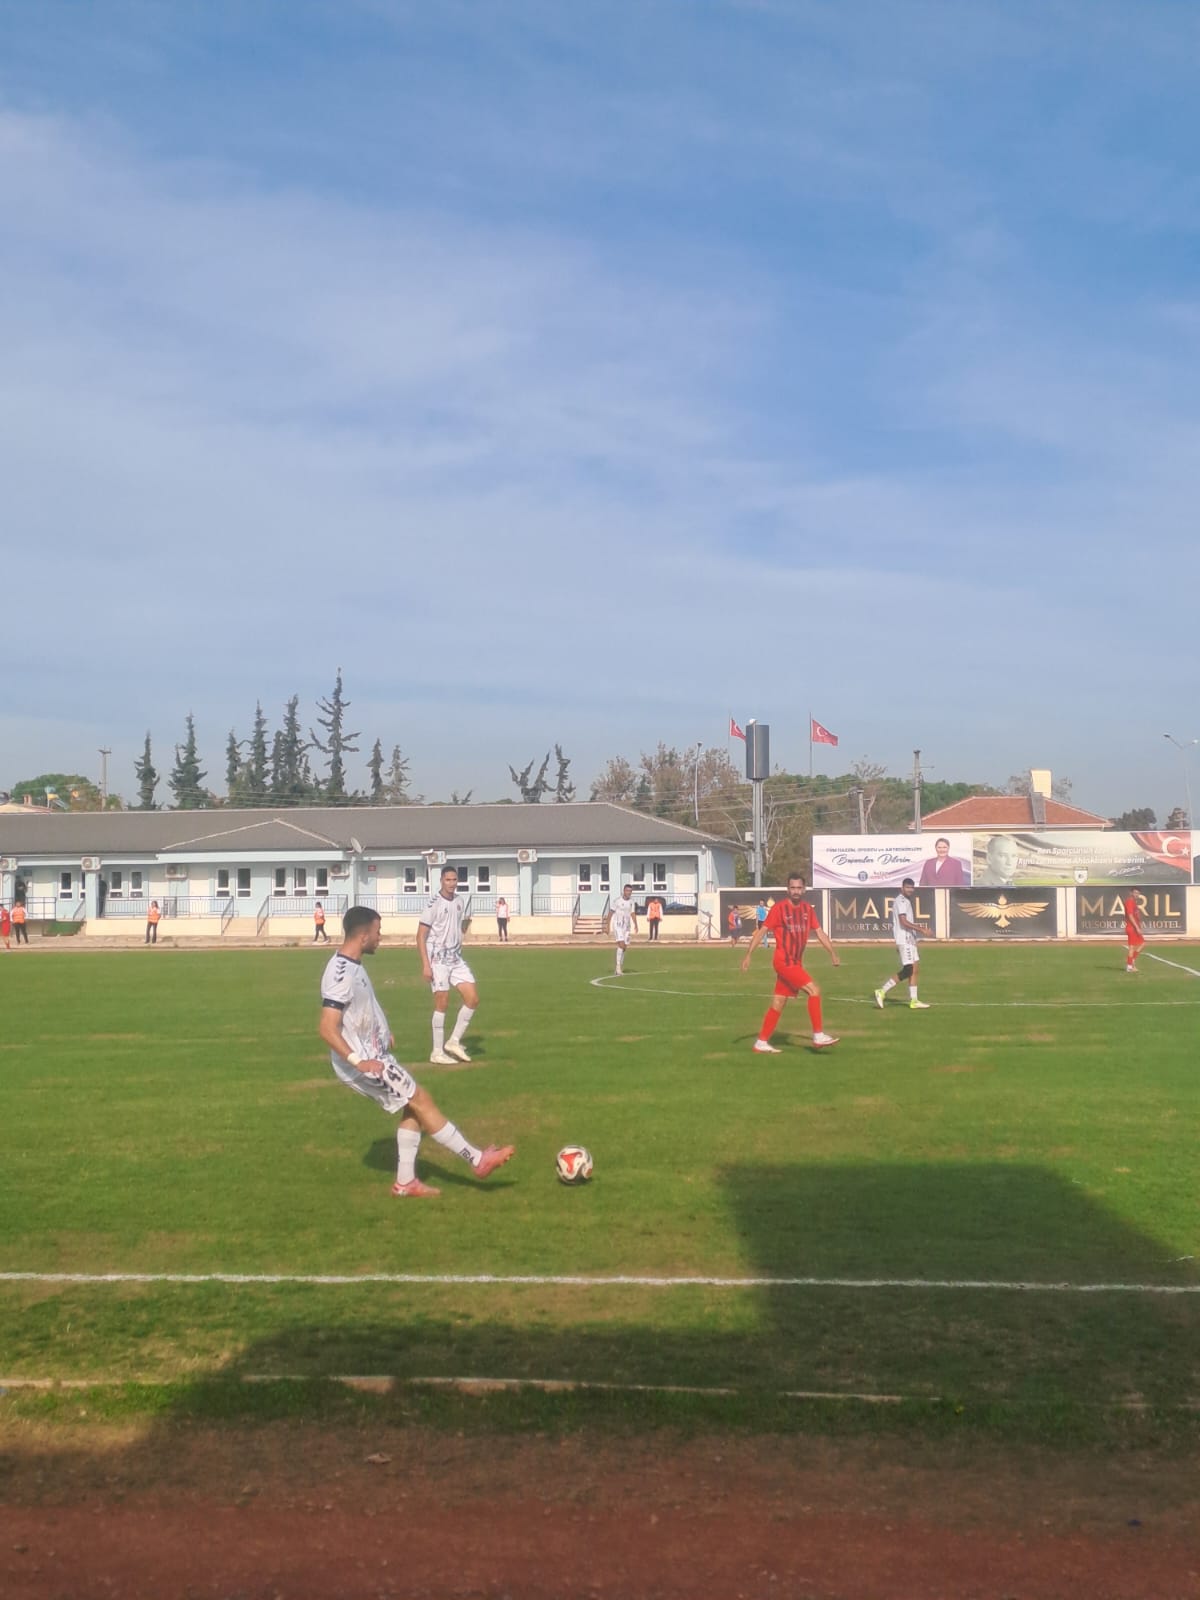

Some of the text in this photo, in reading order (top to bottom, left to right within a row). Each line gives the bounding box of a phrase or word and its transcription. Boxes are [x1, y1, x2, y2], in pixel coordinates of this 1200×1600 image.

[836, 922, 870, 931] RESORT
[872, 922, 879, 931] &
[1082, 920, 1118, 929] RESORT
[1120, 920, 1127, 929] &
[1149, 920, 1181, 929] HOTEL
